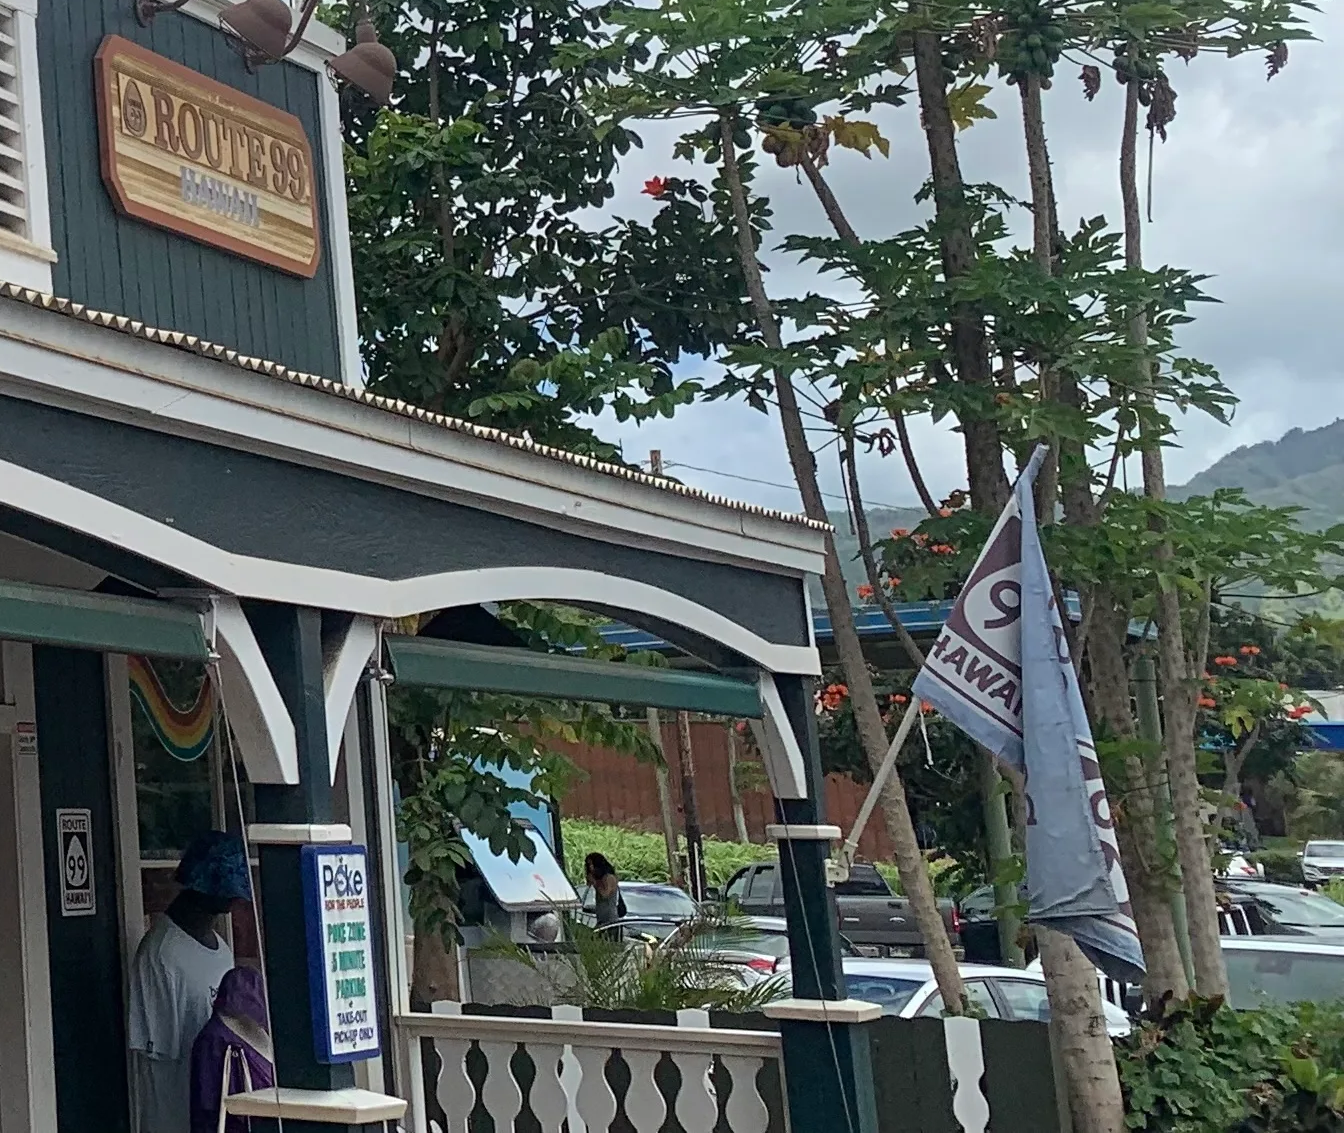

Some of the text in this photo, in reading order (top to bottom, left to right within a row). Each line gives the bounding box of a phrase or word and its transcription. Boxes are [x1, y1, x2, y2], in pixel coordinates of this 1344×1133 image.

[150, 86, 307, 201] ROUTE 99
[62, 818, 87, 831] ROUTE
[68, 855, 85, 881] 99
[323, 863, 363, 897] Poke
[324, 897, 365, 911] FOR THE PEOPLE
[327, 921, 366, 944] POKE ZONE
[337, 1009, 368, 1026] TAKE-OUT
[359, 1026, 374, 1041] ONLY
